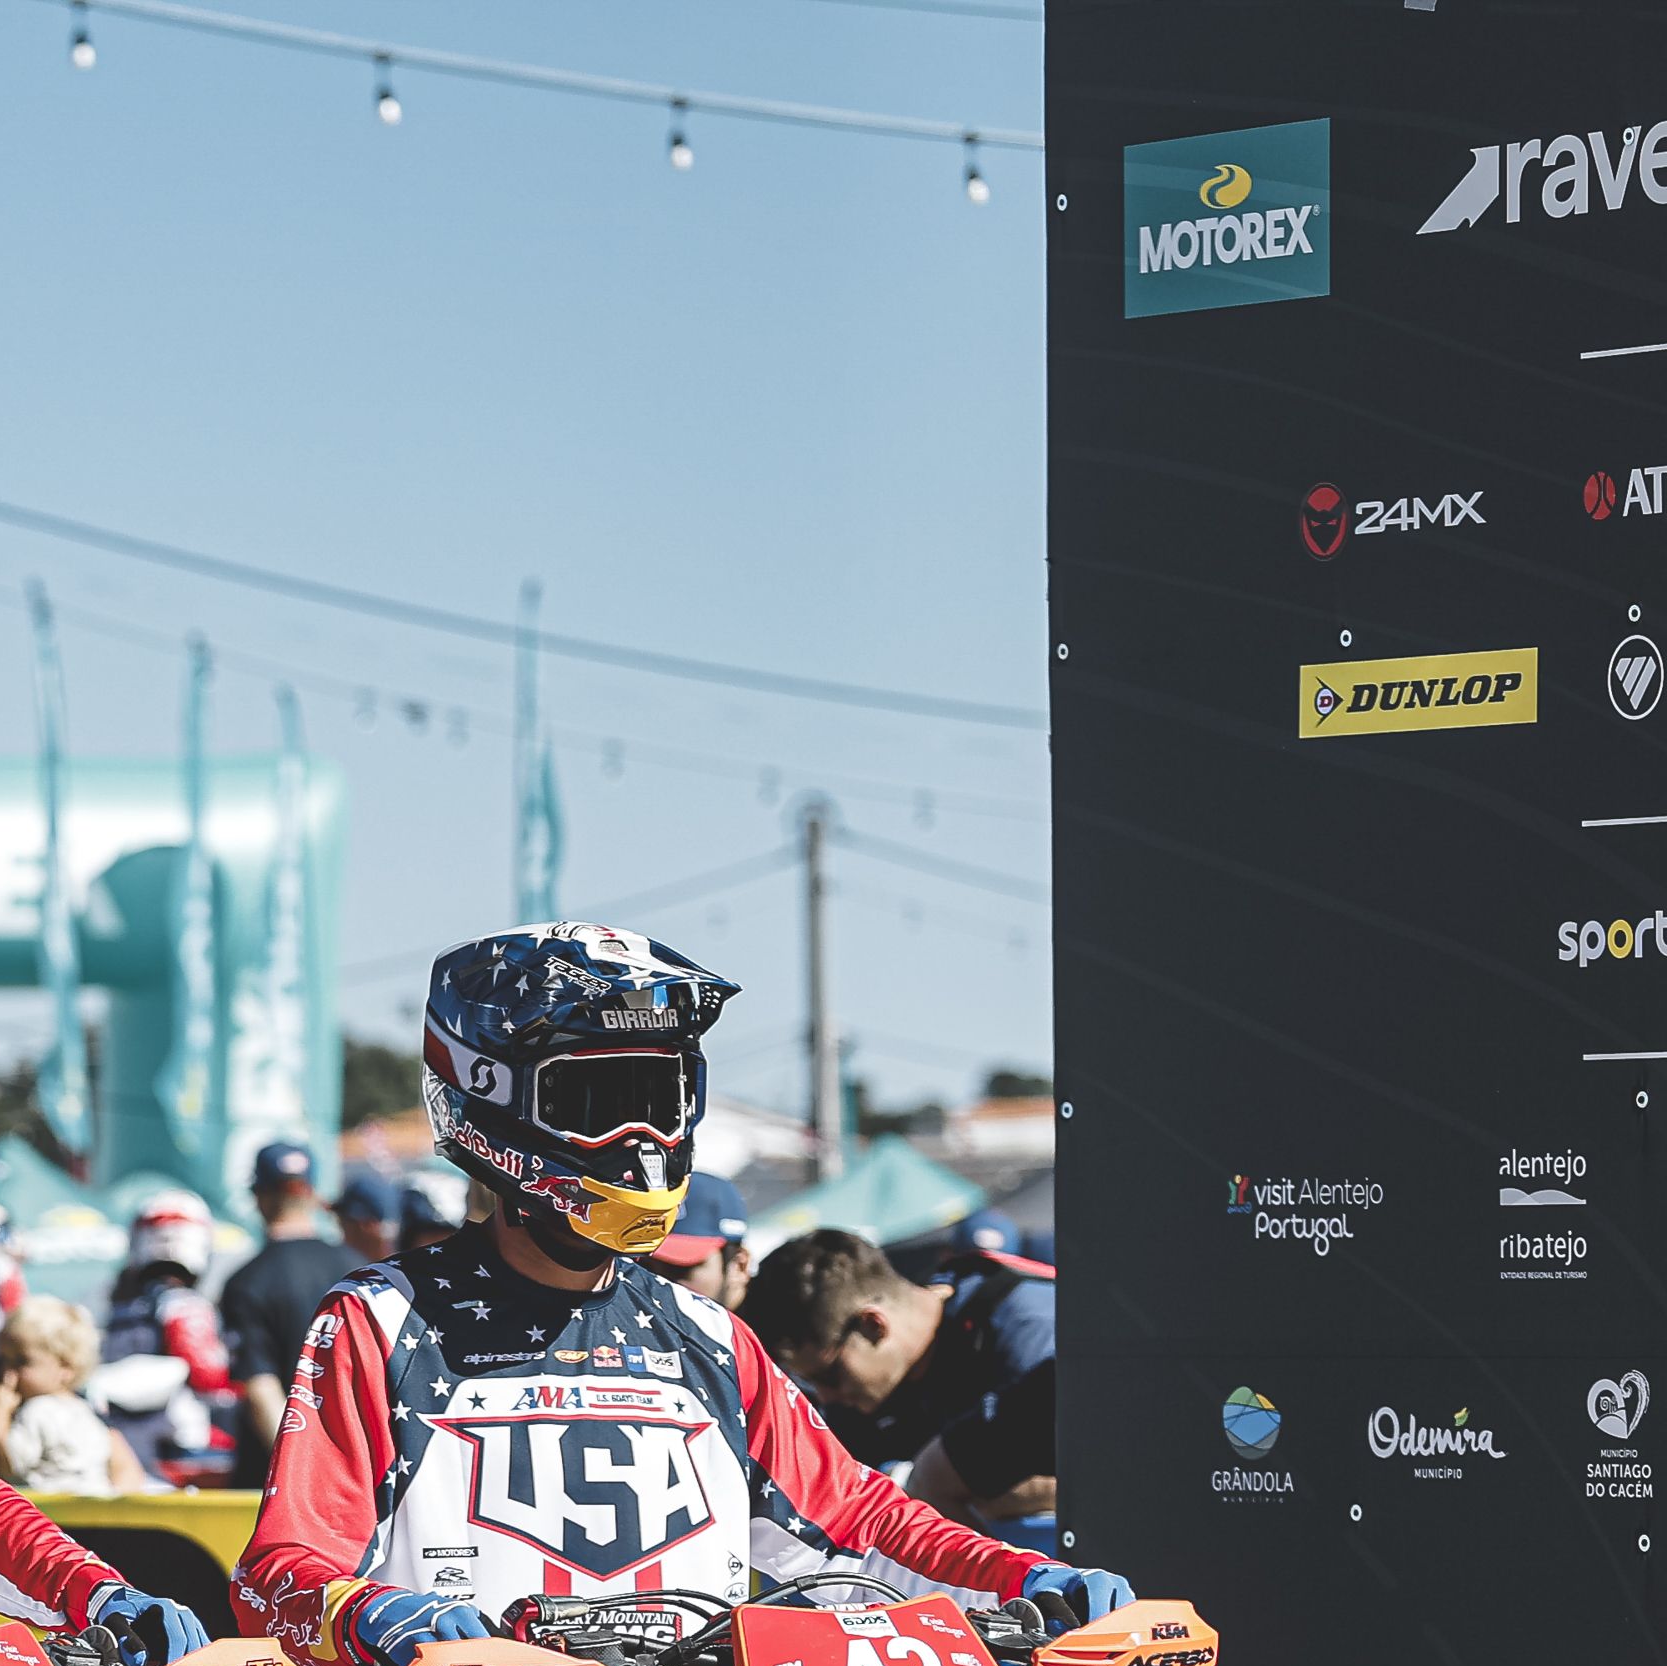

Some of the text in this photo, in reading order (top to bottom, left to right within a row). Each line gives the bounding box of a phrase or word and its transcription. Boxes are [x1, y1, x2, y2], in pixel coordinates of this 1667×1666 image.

[1138, 205, 1315, 275] MOTOREX
[1354, 491, 1486, 535] 24MX
[1346, 673, 1522, 713] DUNLOP
[1499, 1149, 1586, 1184] alentejo
[1254, 1178, 1383, 1209] visit Alentejo
[1255, 1212, 1353, 1256] Portugal
[1500, 1231, 1587, 1265] ribatejo
[1500, 1271, 1527, 1279] ENTIDADE
[1528, 1271, 1554, 1279] REGIONAL
[1564, 1271, 1587, 1279] TURISMO
[464, 1351, 547, 1365] alpinestars
[511, 1385, 586, 1411] AMA
[1368, 1406, 1508, 1459] Odemira
[1211, 1467, 1294, 1493] GRÂNDOLA
[1414, 1466, 1462, 1479] MUNICÍPIO
[1586, 1464, 1653, 1479] SANTIAGO
[466, 1424, 711, 1553] USA
[1586, 1481, 1653, 1498] DO CACÉM
[437, 1548, 476, 1557] MOTOREX
[597, 1611, 675, 1626] MOUNTAIN
[1149, 1620, 1191, 1643] KTM
